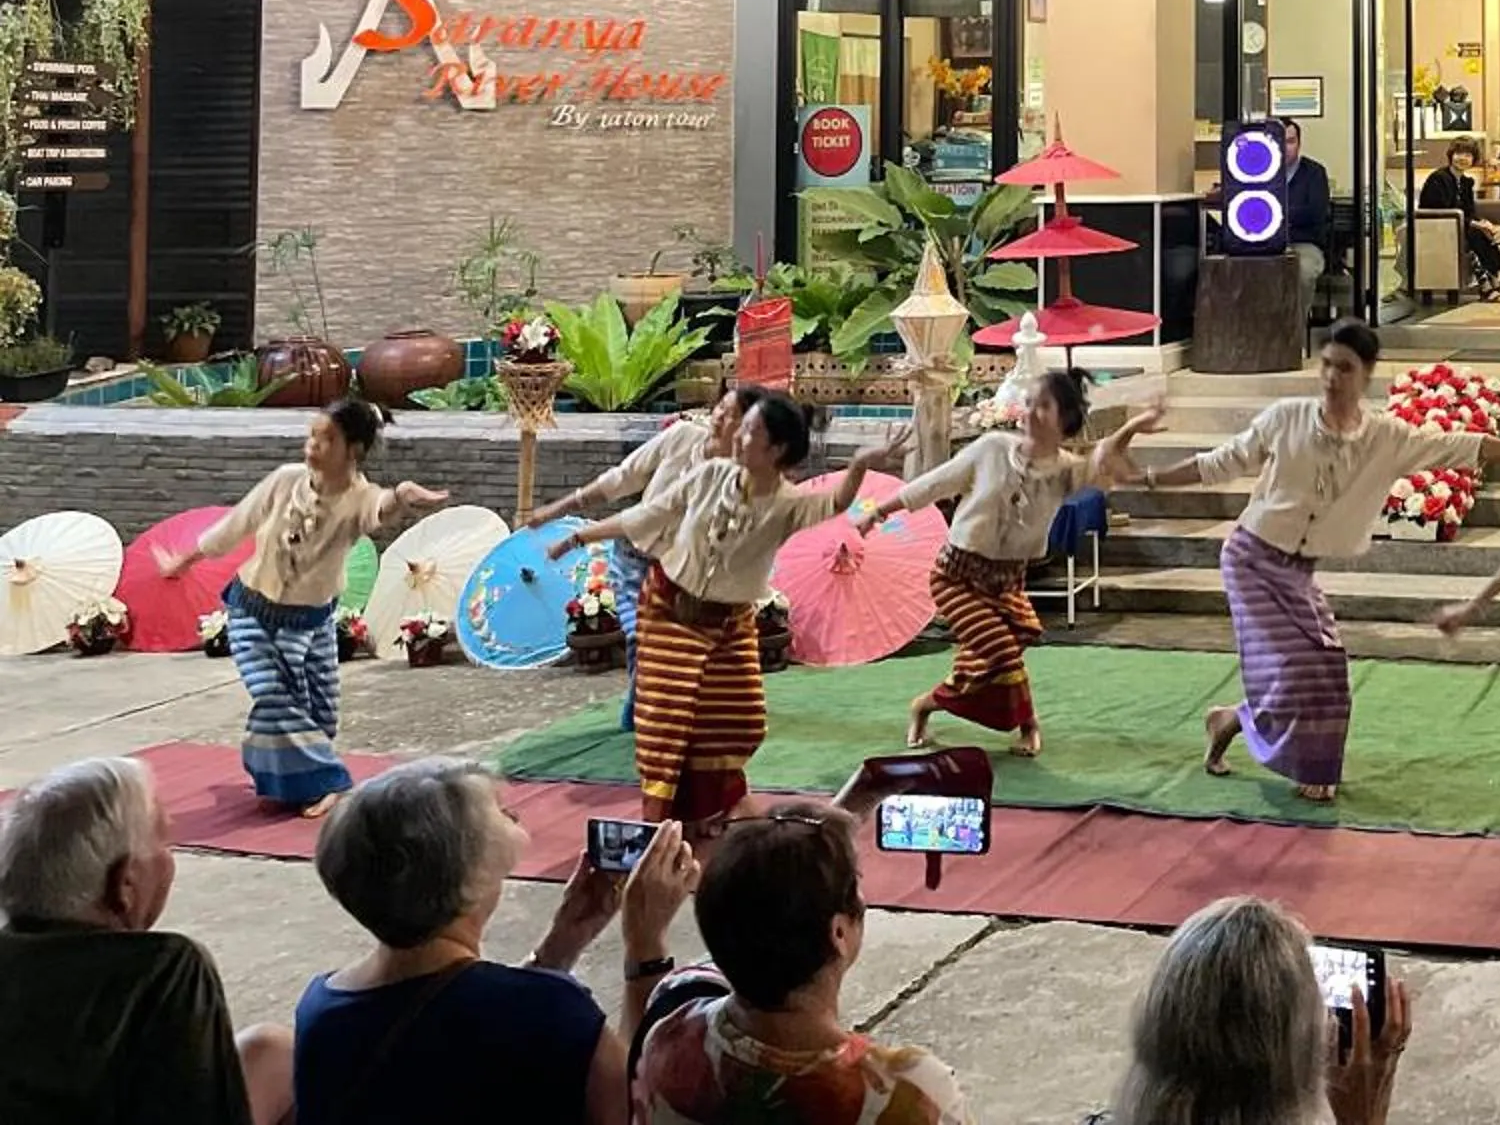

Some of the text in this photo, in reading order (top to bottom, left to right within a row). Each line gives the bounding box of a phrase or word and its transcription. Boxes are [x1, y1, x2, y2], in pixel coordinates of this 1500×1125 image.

[551, 104, 590, 129] By
[812, 118, 851, 130] BOOK
[811, 135, 851, 148] TICKET
